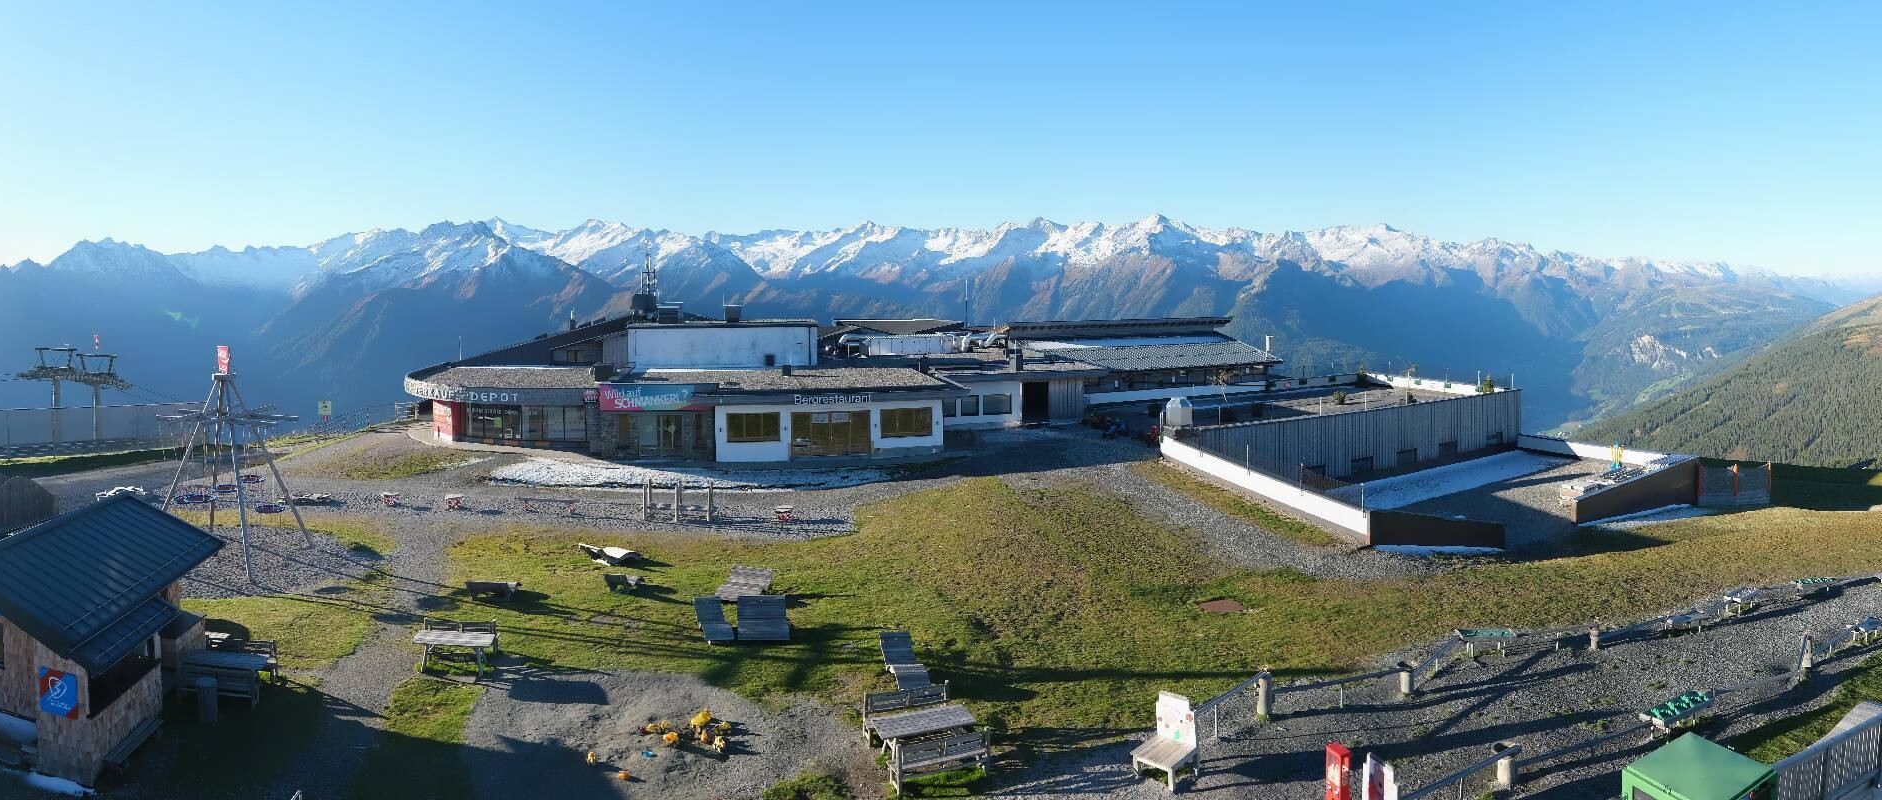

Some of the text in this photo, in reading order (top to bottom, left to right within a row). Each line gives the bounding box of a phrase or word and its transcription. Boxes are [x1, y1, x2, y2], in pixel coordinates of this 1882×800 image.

[470, 391, 519, 402] DEPOT
[605, 388, 625, 399] Wild
[626, 386, 642, 398] auf
[794, 393, 871, 405] Bergrestaurant
